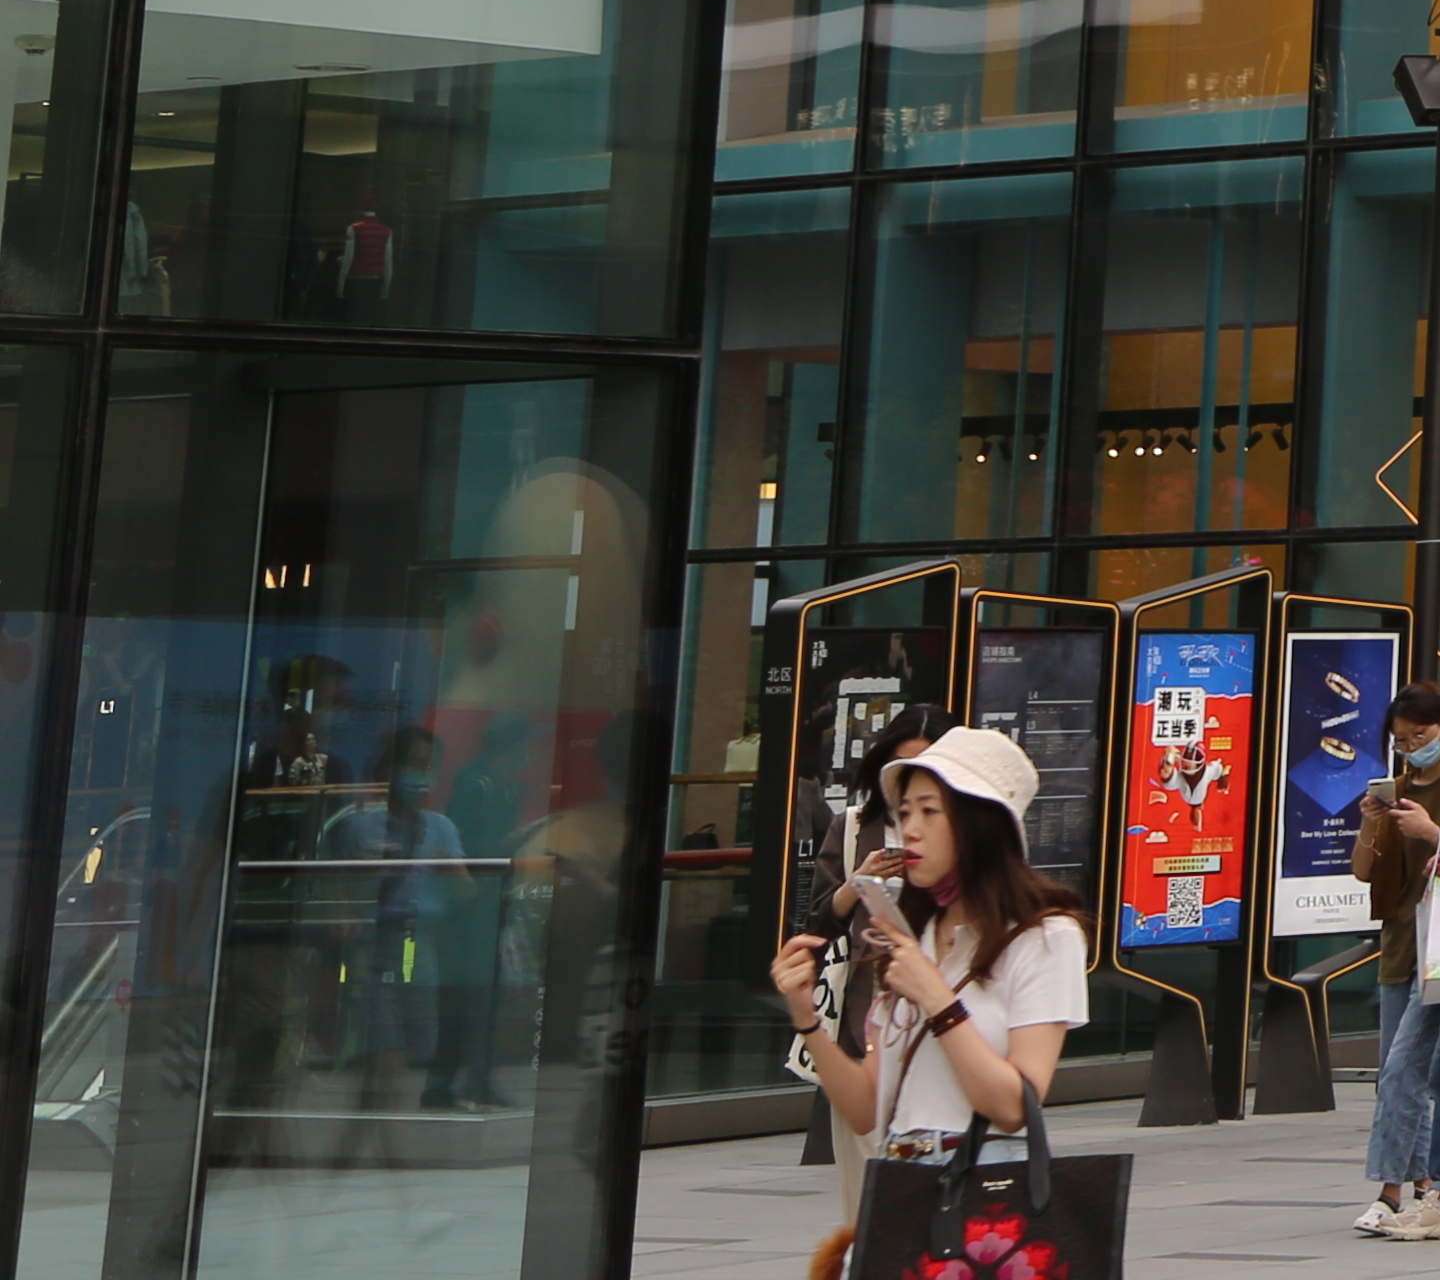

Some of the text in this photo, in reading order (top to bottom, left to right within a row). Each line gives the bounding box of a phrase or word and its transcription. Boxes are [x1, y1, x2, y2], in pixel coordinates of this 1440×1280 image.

[767, 667, 793, 683] 北区
[765, 686, 792, 694] NORTH
[99, 700, 115, 715] L1
[1158, 691, 1192, 711] 潮玩
[1155, 719, 1197, 739] 正当季
[798, 838, 814, 858] L1
[1295, 893, 1367, 909] CHAUMET
